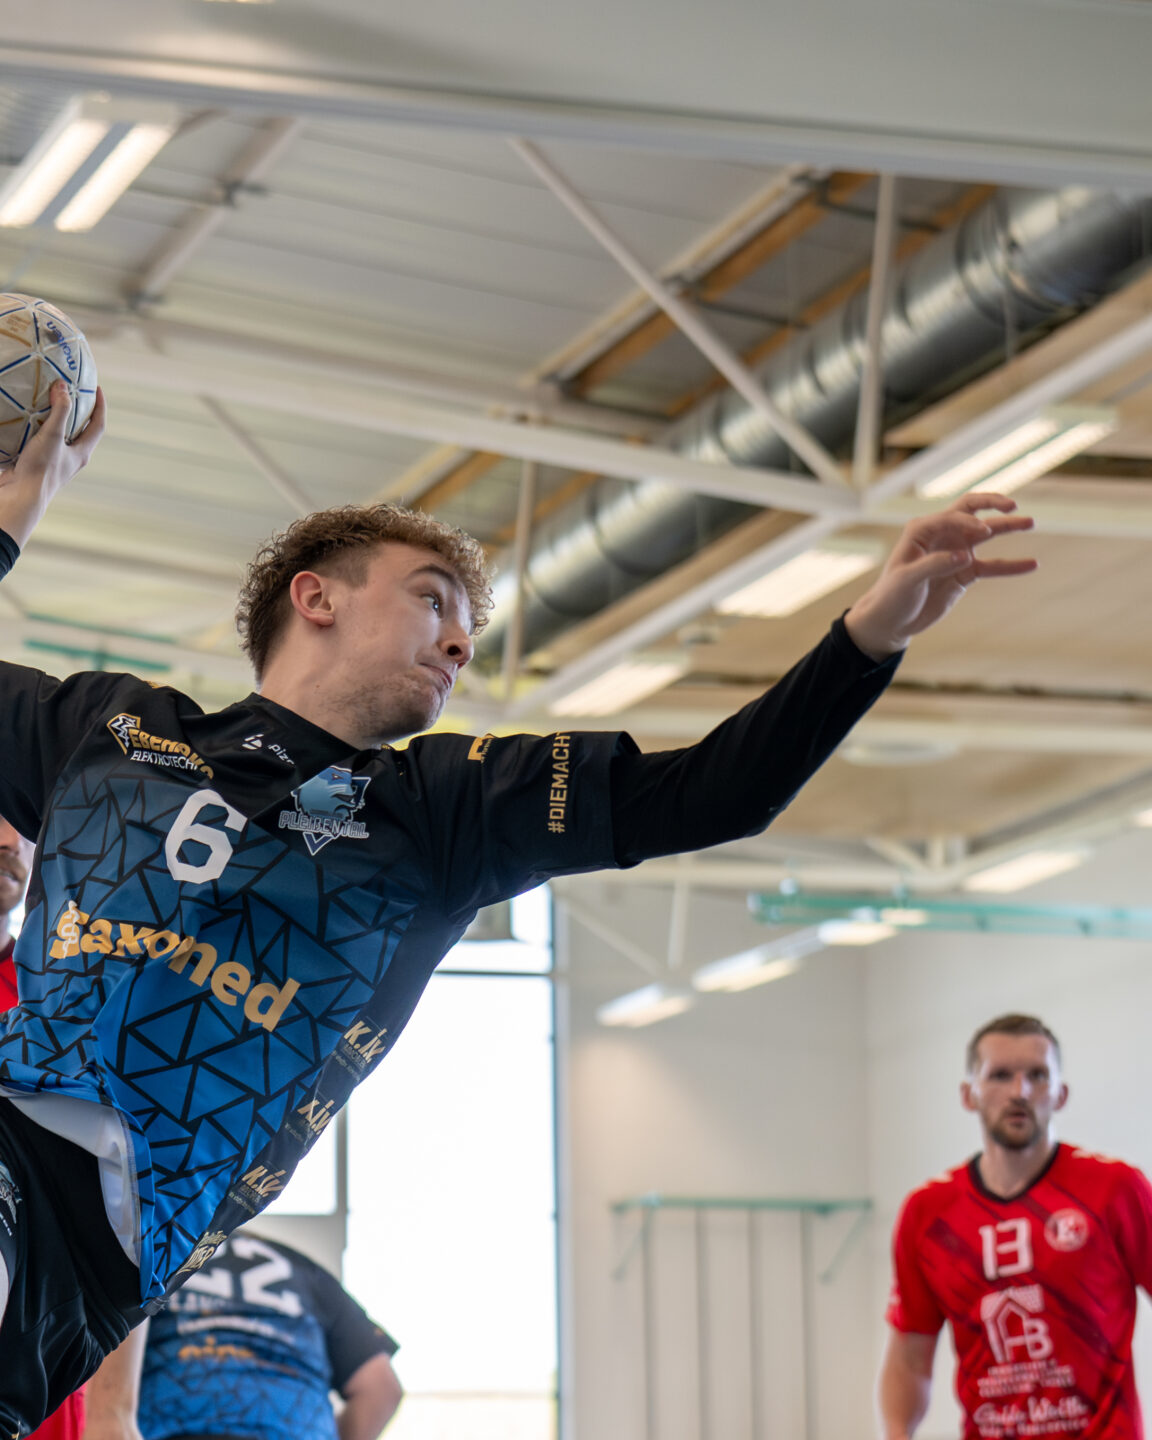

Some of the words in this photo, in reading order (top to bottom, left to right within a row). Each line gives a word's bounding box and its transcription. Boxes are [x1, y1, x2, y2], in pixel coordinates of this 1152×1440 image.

[547, 732, 570, 834] #DIEMACH
[165, 788, 248, 884] 6
[978, 1216, 1034, 1281] 13
